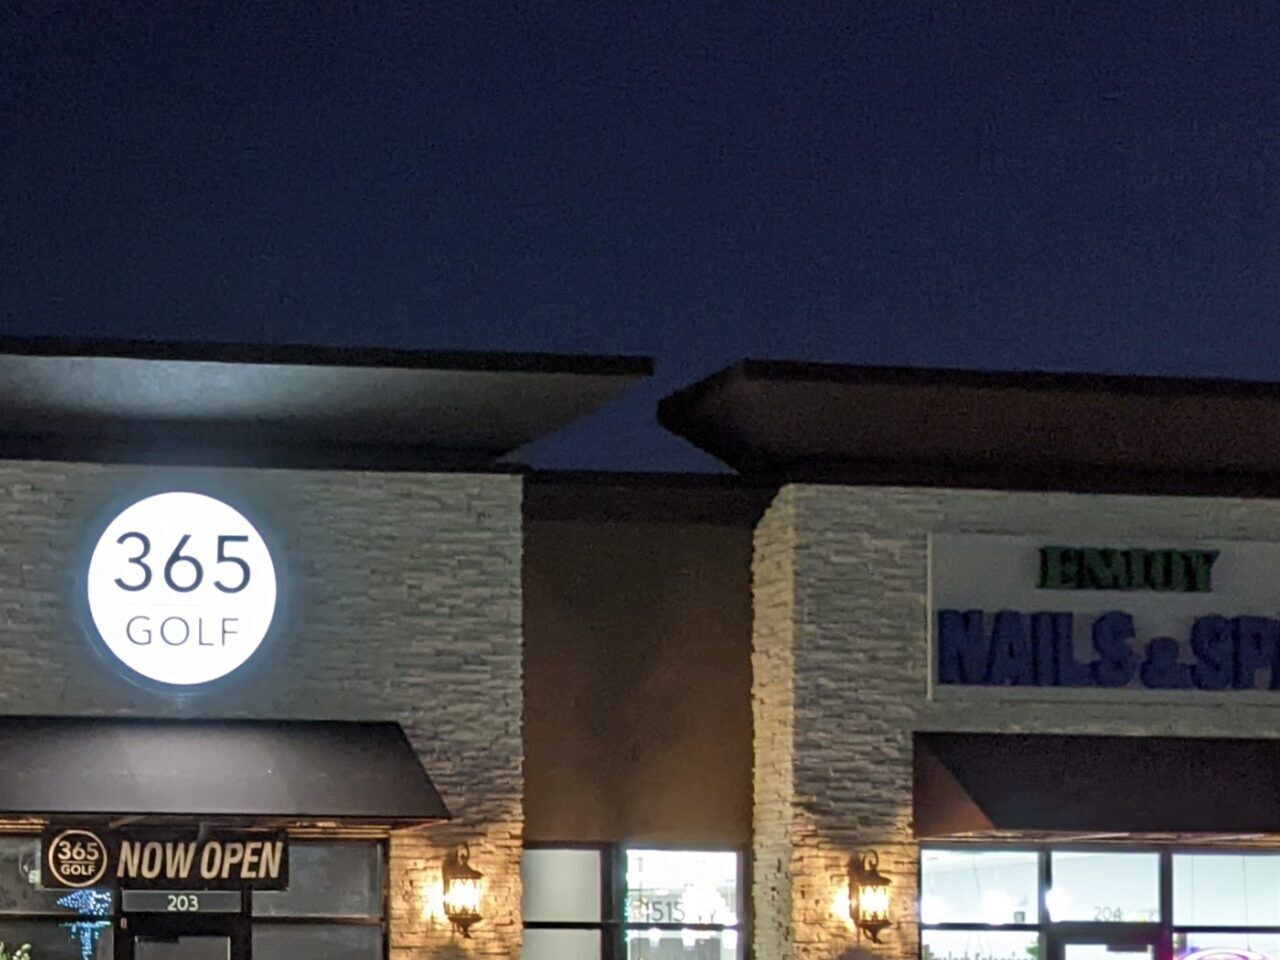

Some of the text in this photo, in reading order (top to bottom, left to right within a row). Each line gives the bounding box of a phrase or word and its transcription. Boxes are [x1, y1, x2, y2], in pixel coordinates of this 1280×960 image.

[114, 531, 251, 594] 365
[126, 615, 239, 647] GOLF
[58, 840, 99, 861] 365
[117, 840, 283, 879] NOW OPEN
[60, 865, 95, 876] GOLF
[168, 895, 199, 911] 203
[1093, 906, 1122, 921] 204
